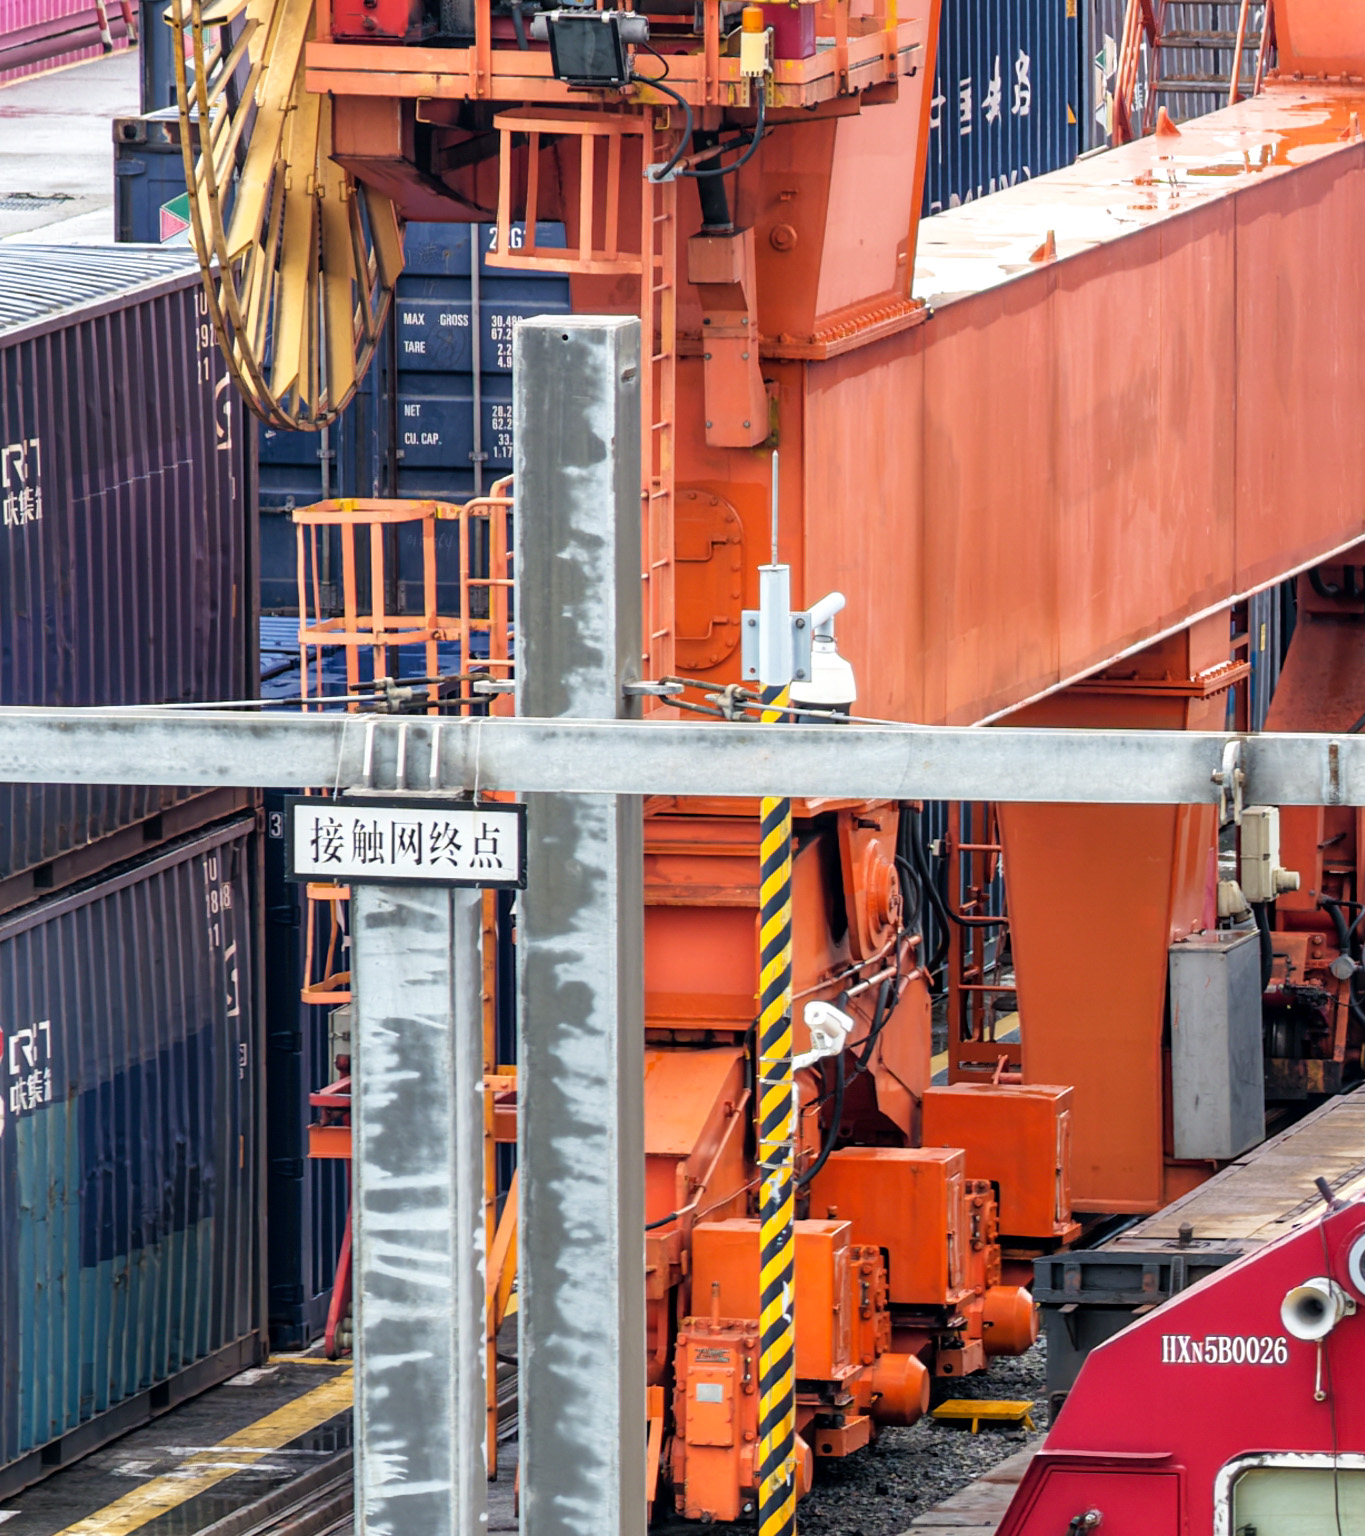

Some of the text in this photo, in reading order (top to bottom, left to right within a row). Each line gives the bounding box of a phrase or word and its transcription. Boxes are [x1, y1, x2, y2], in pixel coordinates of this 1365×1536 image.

[403, 313, 425, 325] MAX
[440, 314, 469, 327] GROSS
[404, 341, 426, 354] TARE
[404, 404, 421, 417] NET
[309, 816, 505, 869] 接触网终点
